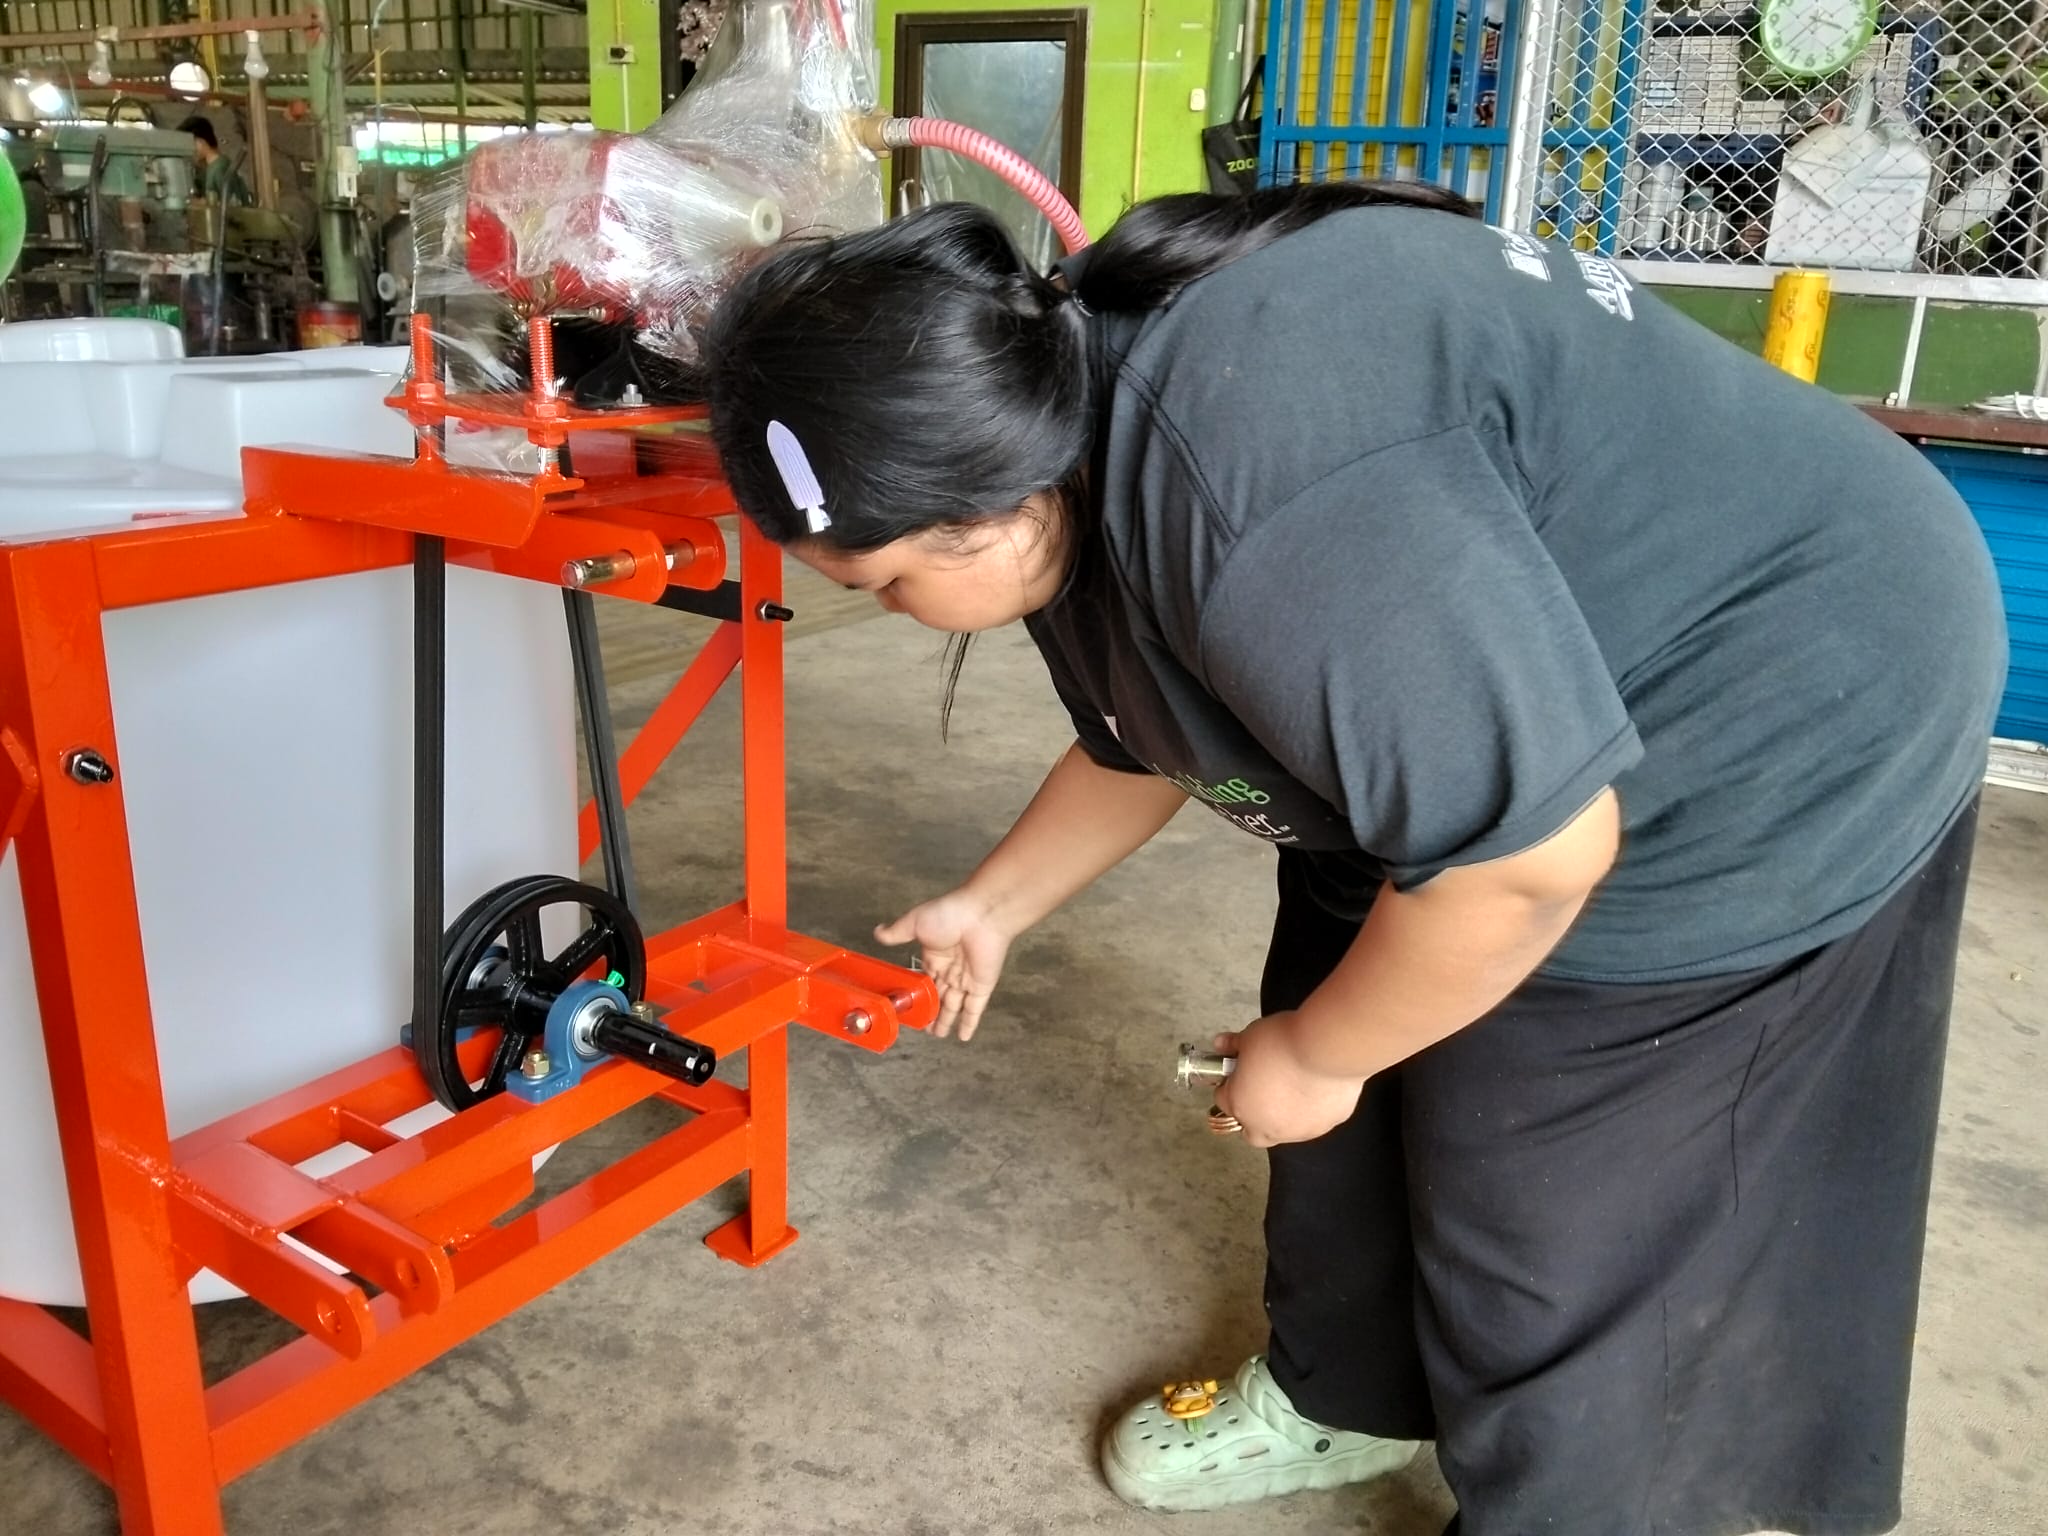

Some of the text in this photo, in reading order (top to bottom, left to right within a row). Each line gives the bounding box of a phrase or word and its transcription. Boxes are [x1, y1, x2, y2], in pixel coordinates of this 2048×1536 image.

[1769, 13, 1780, 27] 9
[1854, 12, 1865, 26] 3
[1772, 36, 1783, 49] 8
[1842, 35, 1857, 49] 4
[1789, 48, 1801, 64] 7
[1804, 53, 1816, 68] 6
[1825, 49, 1836, 63] 5
